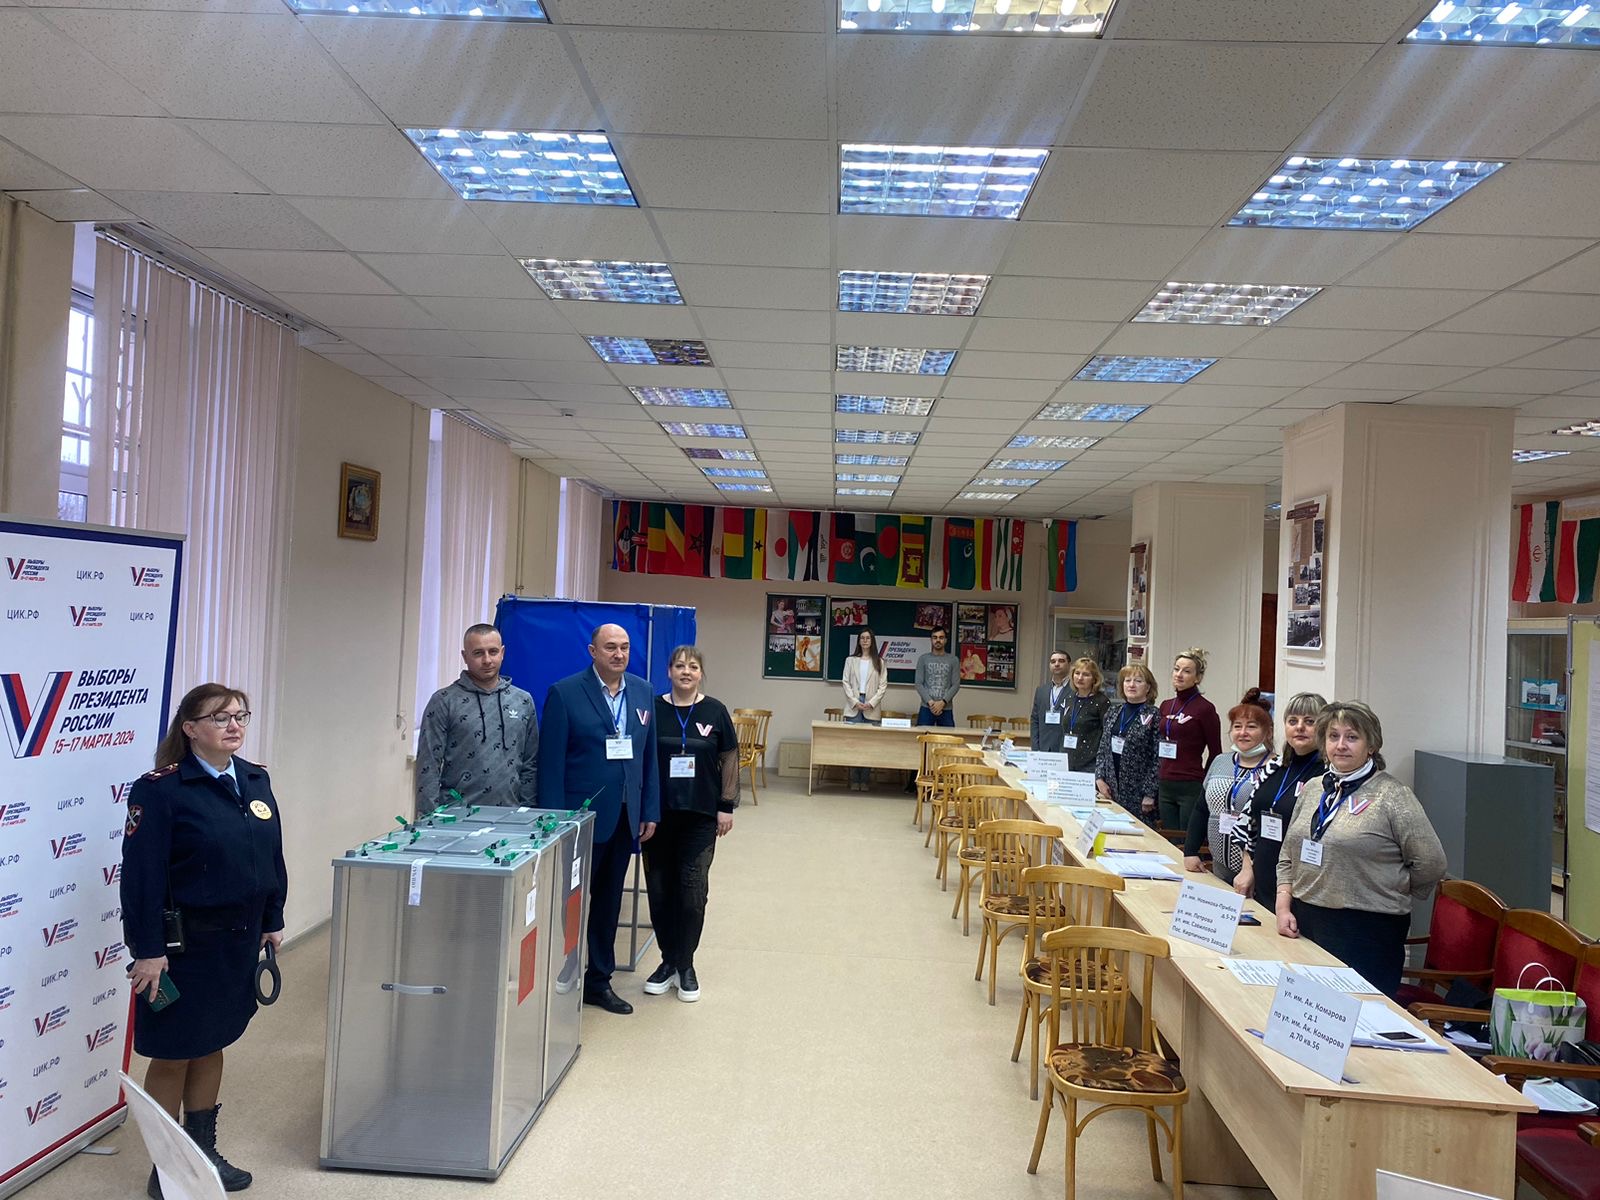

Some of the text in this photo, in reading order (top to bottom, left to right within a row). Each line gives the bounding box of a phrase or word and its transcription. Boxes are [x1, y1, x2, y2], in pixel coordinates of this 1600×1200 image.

[76, 570, 104, 580] ЦИК.РФ
[7, 610, 39, 620] ЦИК.РФ
[130, 612, 154, 621] ЦИК.РФ
[78, 668, 136, 687] ВЫБОРЫ
[68, 688, 149, 710] ПРЕЗИДЕНТА
[60, 712, 115, 734] РОССИИ
[80, 733, 112, 750] МАРТА
[113, 730, 135, 746] 2024
[57, 797, 84, 811] ЦИК.РФ
[109, 828, 123, 840] ЦИК
[50, 883, 76, 899] ЦИК.РФ
[101, 908, 121, 922] ЦИК.Р
[42, 969, 68, 987] ЦИК.РФ
[92, 988, 116, 1005] ЦИК.РФ
[1284, 990, 1346, 1022] ул. им. Ак. Комарова
[1274, 1010, 1344, 1049] по ул. им. Ак. Комарова
[1289, 1031, 1320, 1051] д.70 кв.56
[33, 1056, 60, 1077] ЦИК.РФ
[84, 1069, 108, 1088] ЦИК.РФ
